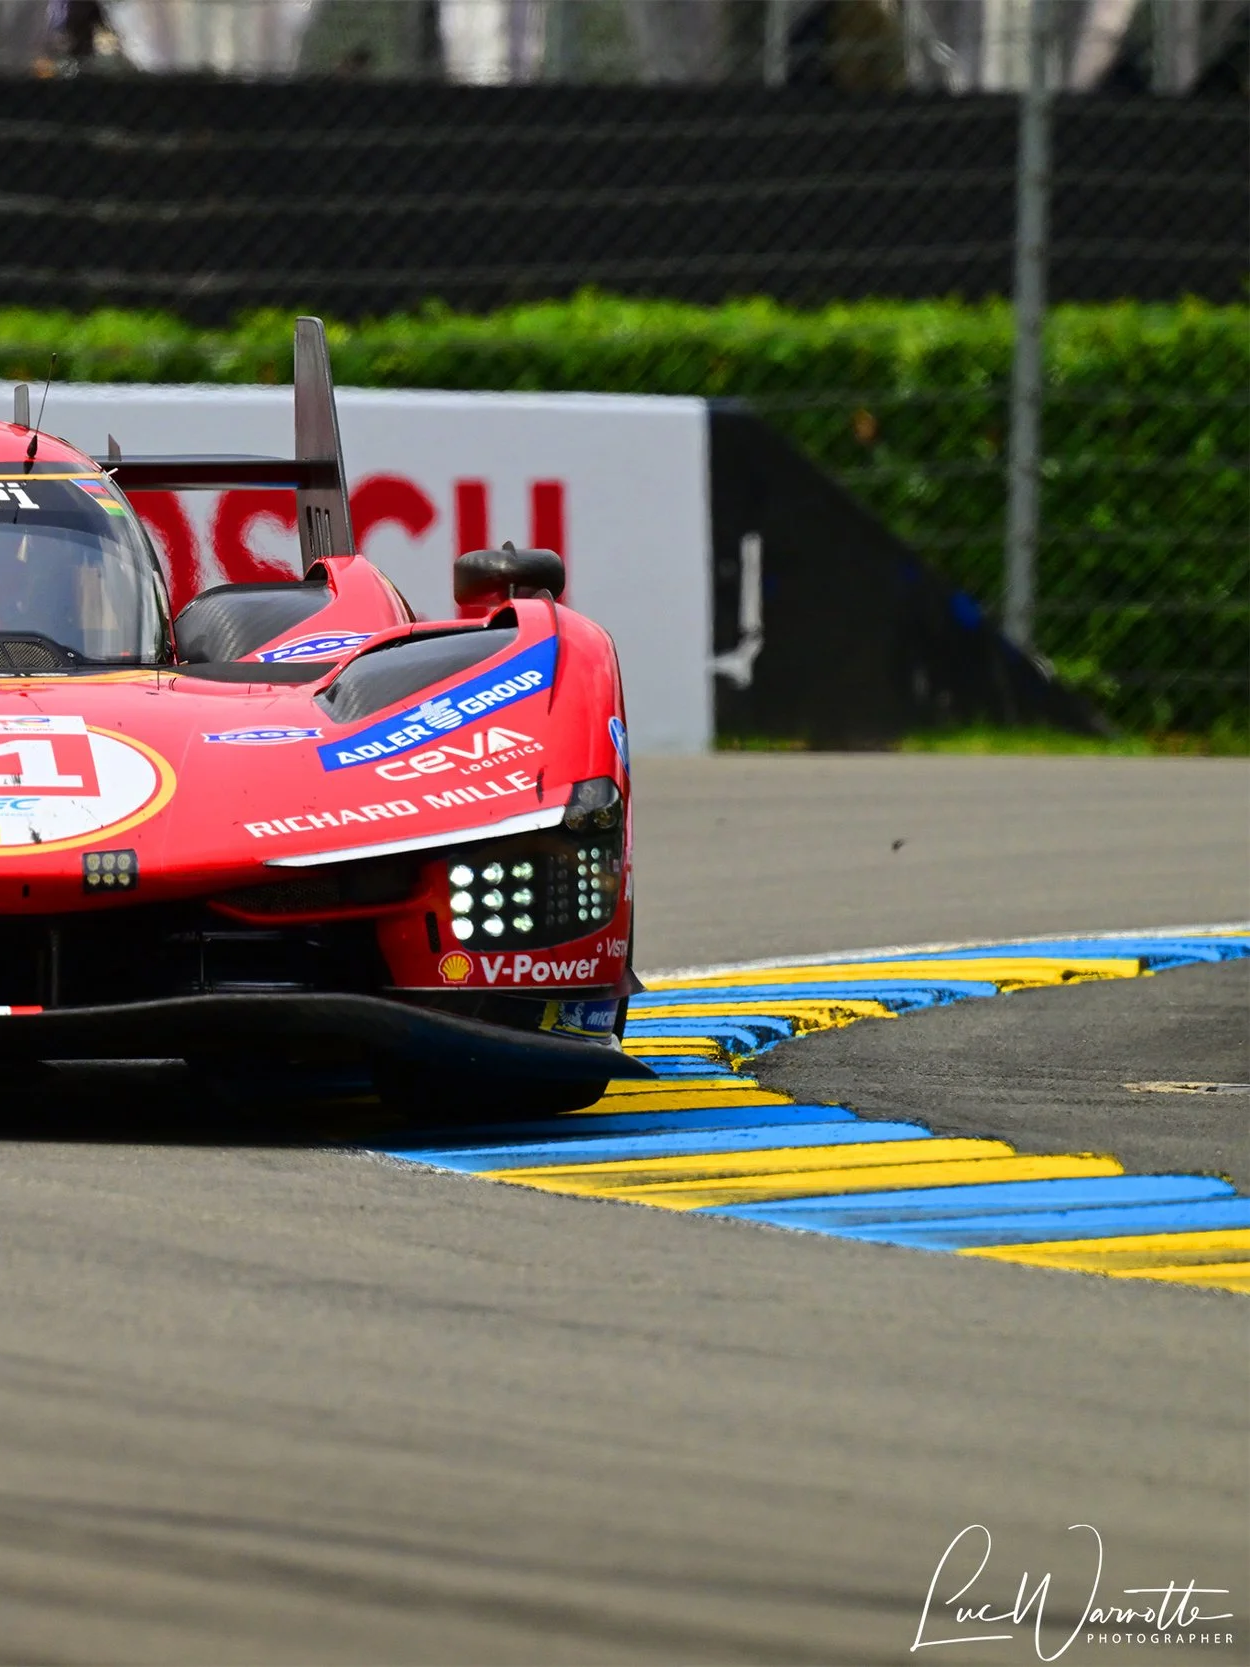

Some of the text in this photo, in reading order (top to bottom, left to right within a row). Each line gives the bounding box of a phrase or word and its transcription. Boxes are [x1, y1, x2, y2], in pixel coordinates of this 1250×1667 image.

[336, 670, 543, 765] ADLER GROUP
[459, 742, 544, 775] LOGISTICS
[244, 770, 538, 839] RICHARD MILLE
[480, 955, 600, 984] V-Power
